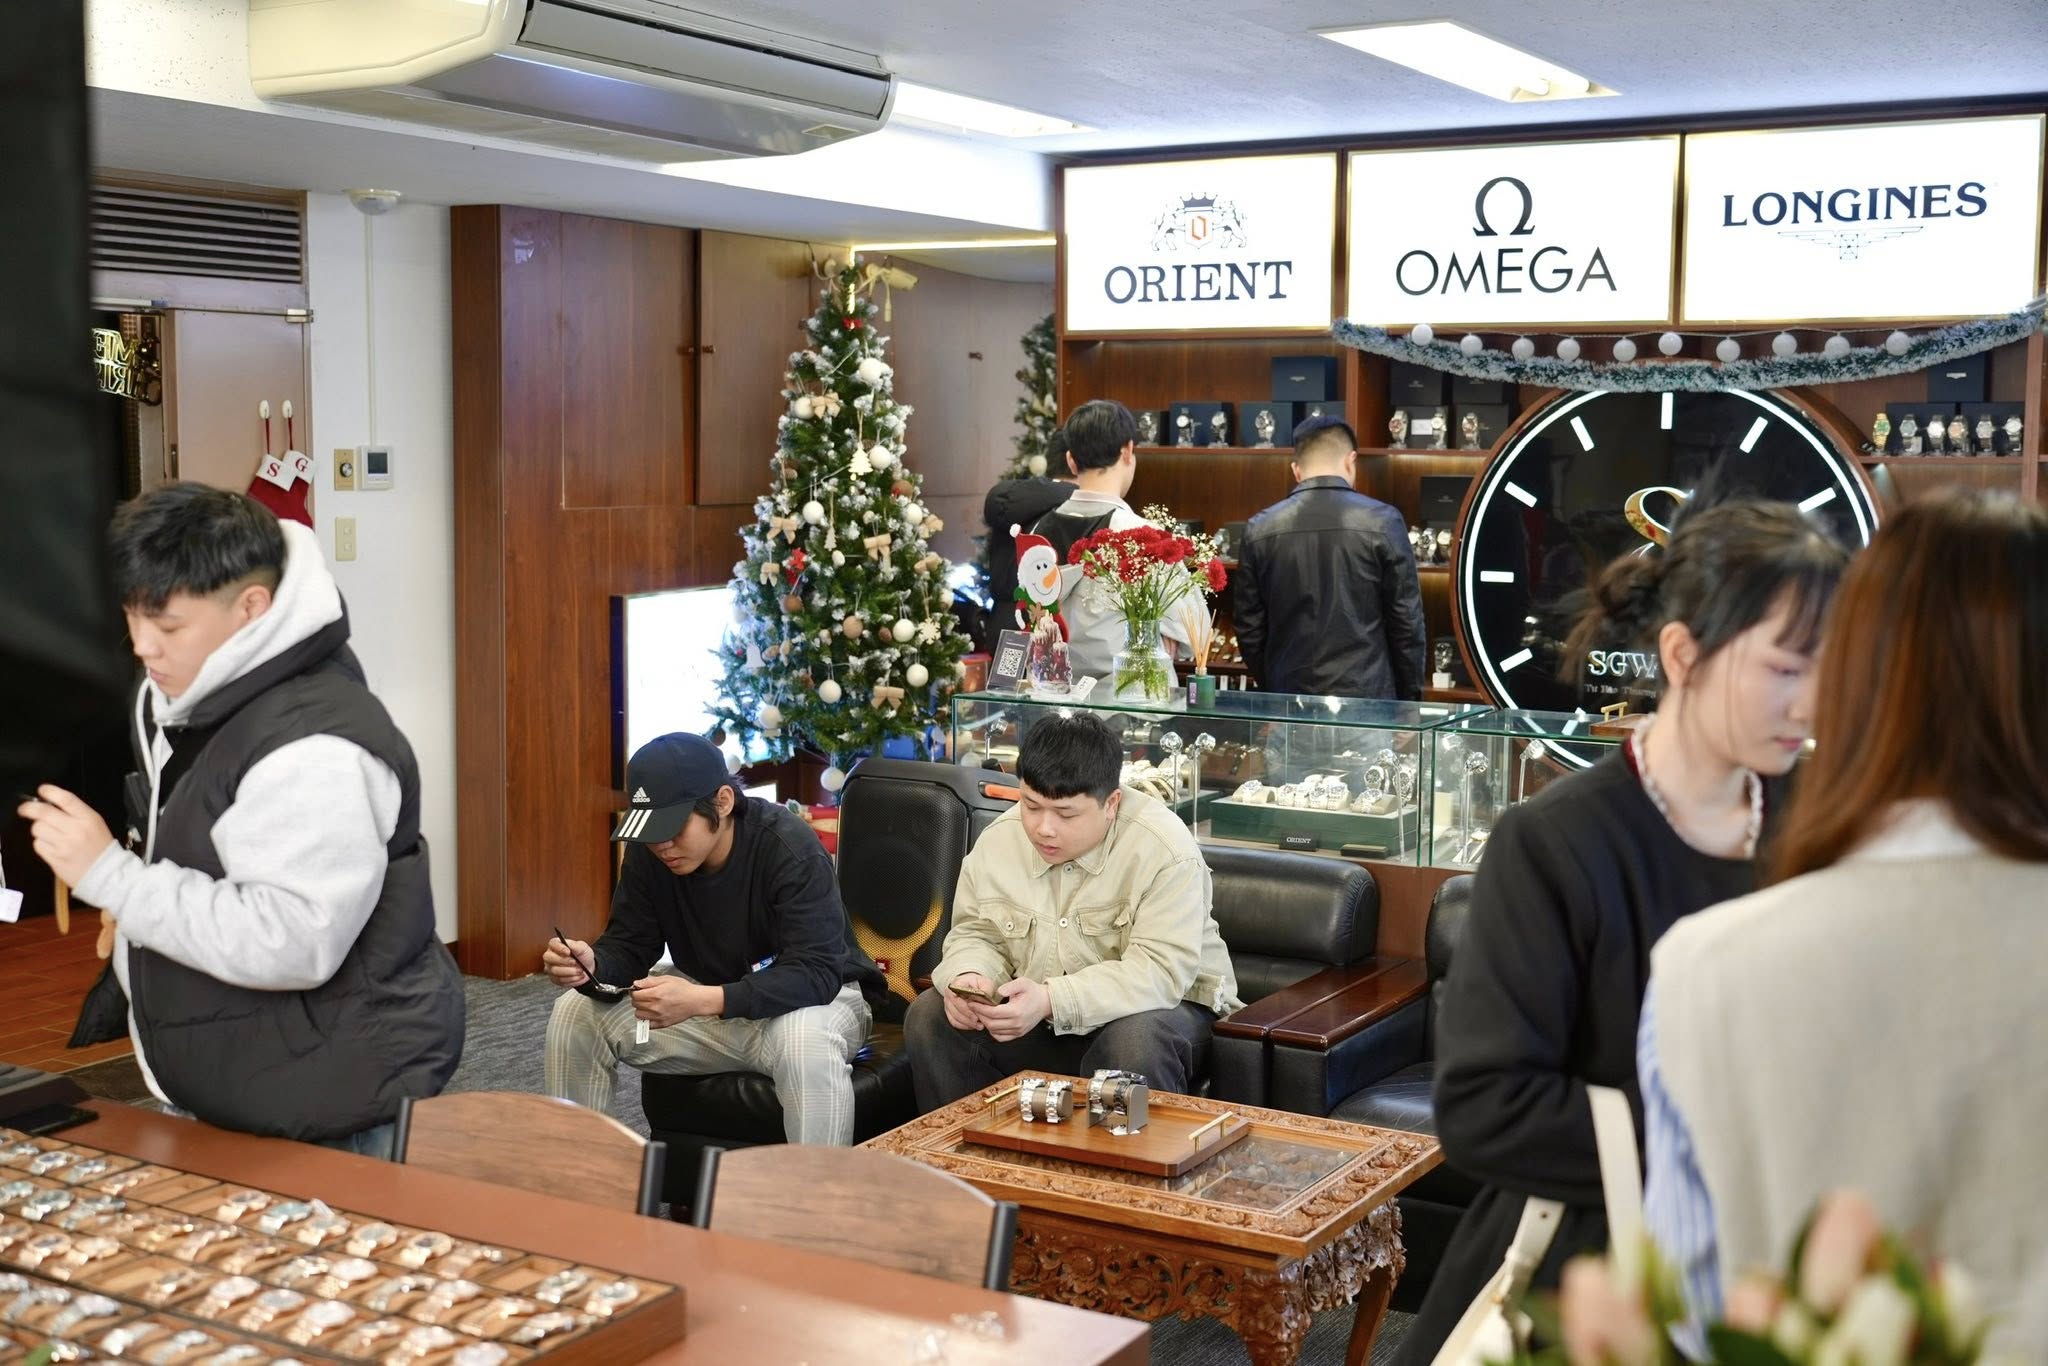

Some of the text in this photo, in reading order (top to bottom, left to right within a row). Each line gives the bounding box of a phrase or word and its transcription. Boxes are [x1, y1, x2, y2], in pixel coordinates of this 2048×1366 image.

[1722, 182, 1988, 227] LONGINES
[1104, 260, 1292, 304] ORIENT
[1395, 245, 1617, 296] OMEGA
[266, 462, 281, 477] S
[295, 457, 308, 472] G
[1286, 836, 1312, 844] ORIENT
